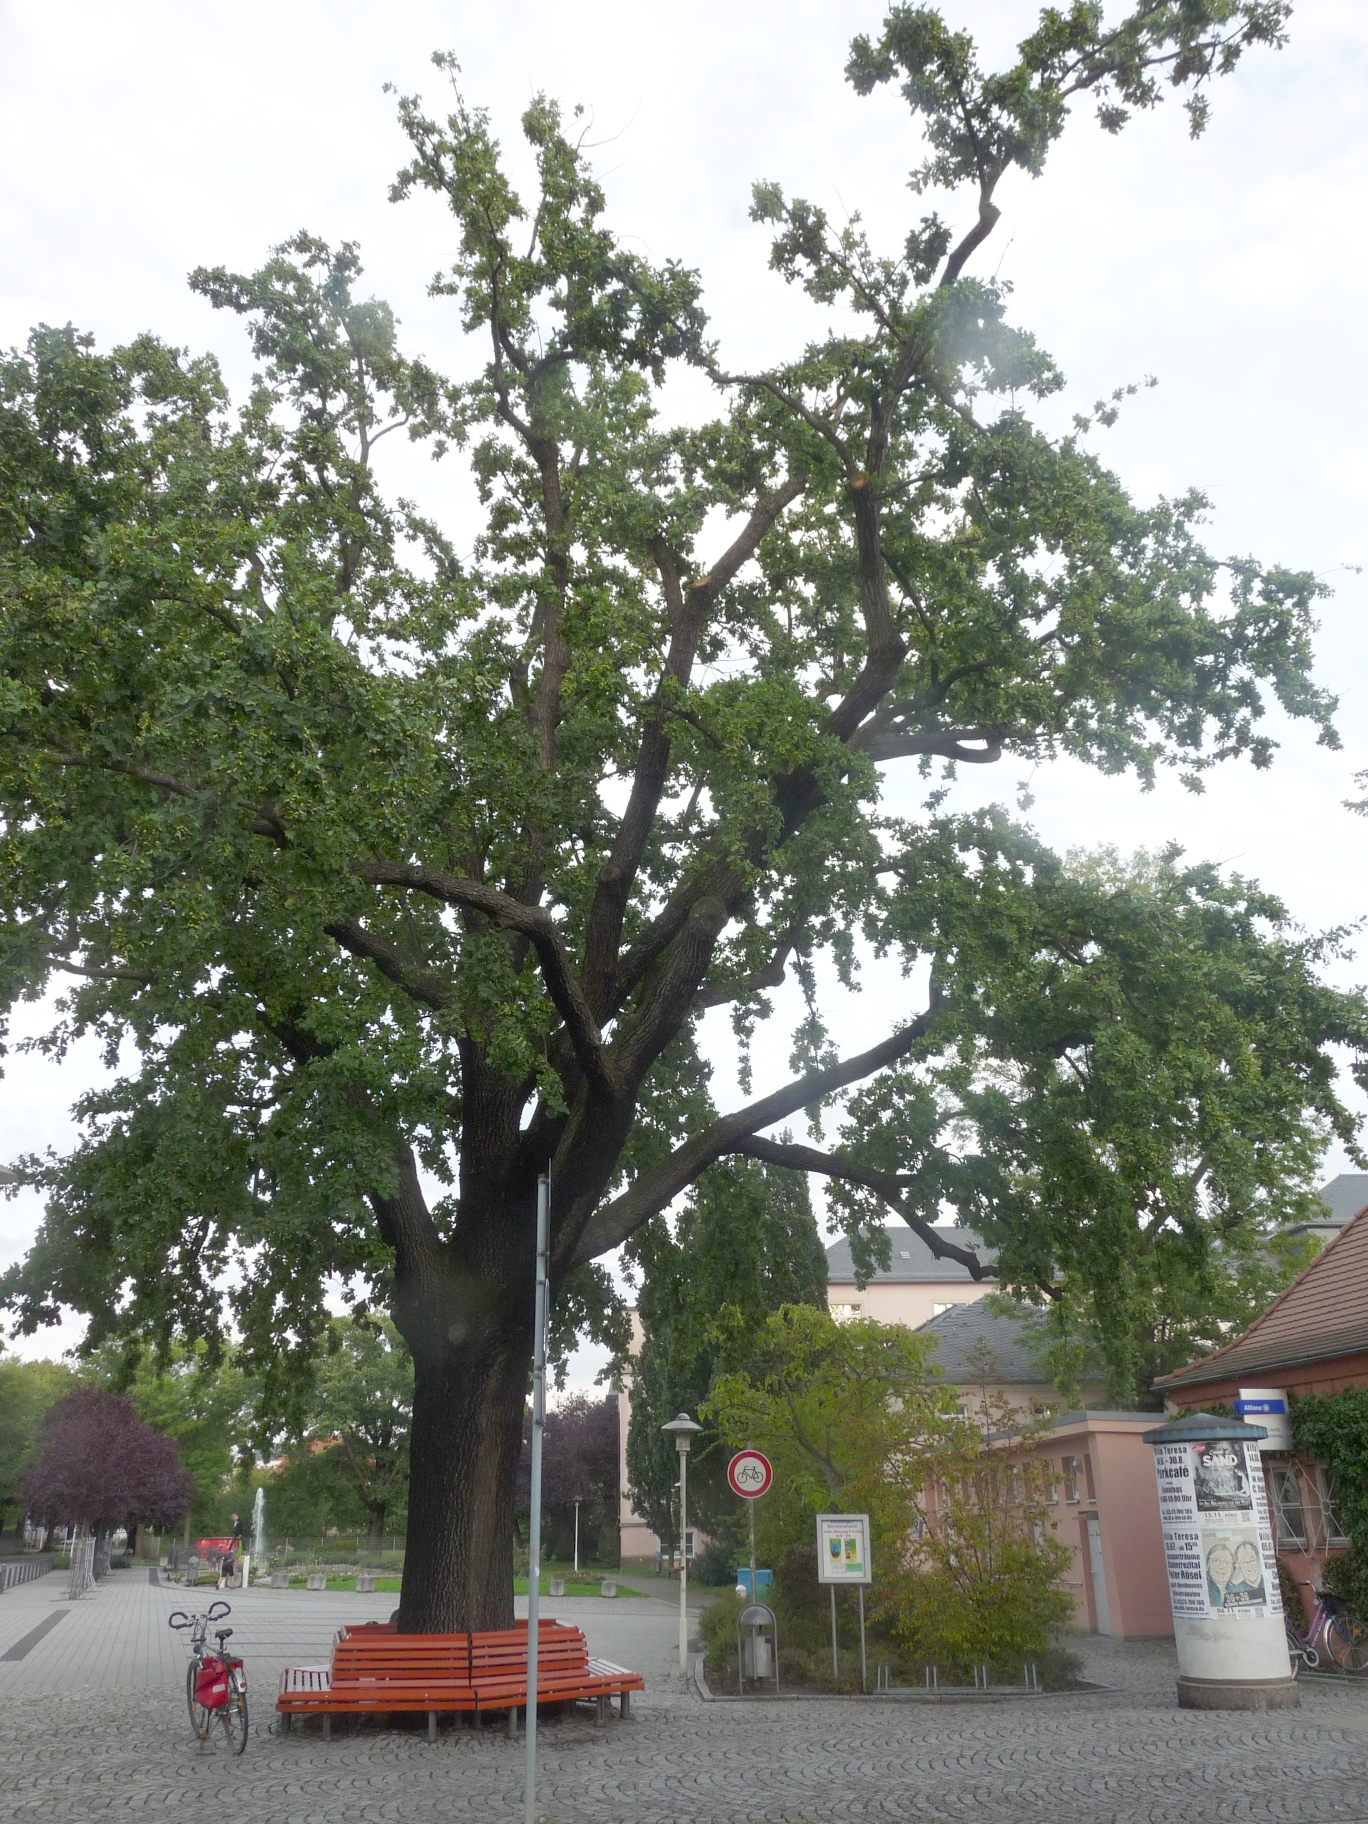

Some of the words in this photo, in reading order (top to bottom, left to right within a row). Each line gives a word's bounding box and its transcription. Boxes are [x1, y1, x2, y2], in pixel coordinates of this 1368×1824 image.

[1164, 1446, 1187, 1455] Teresa
[1202, 1454, 1238, 1467] SAND
[1174, 1532, 1199, 1541] Teresa
[1180, 1570, 1202, 1580] Rösel
